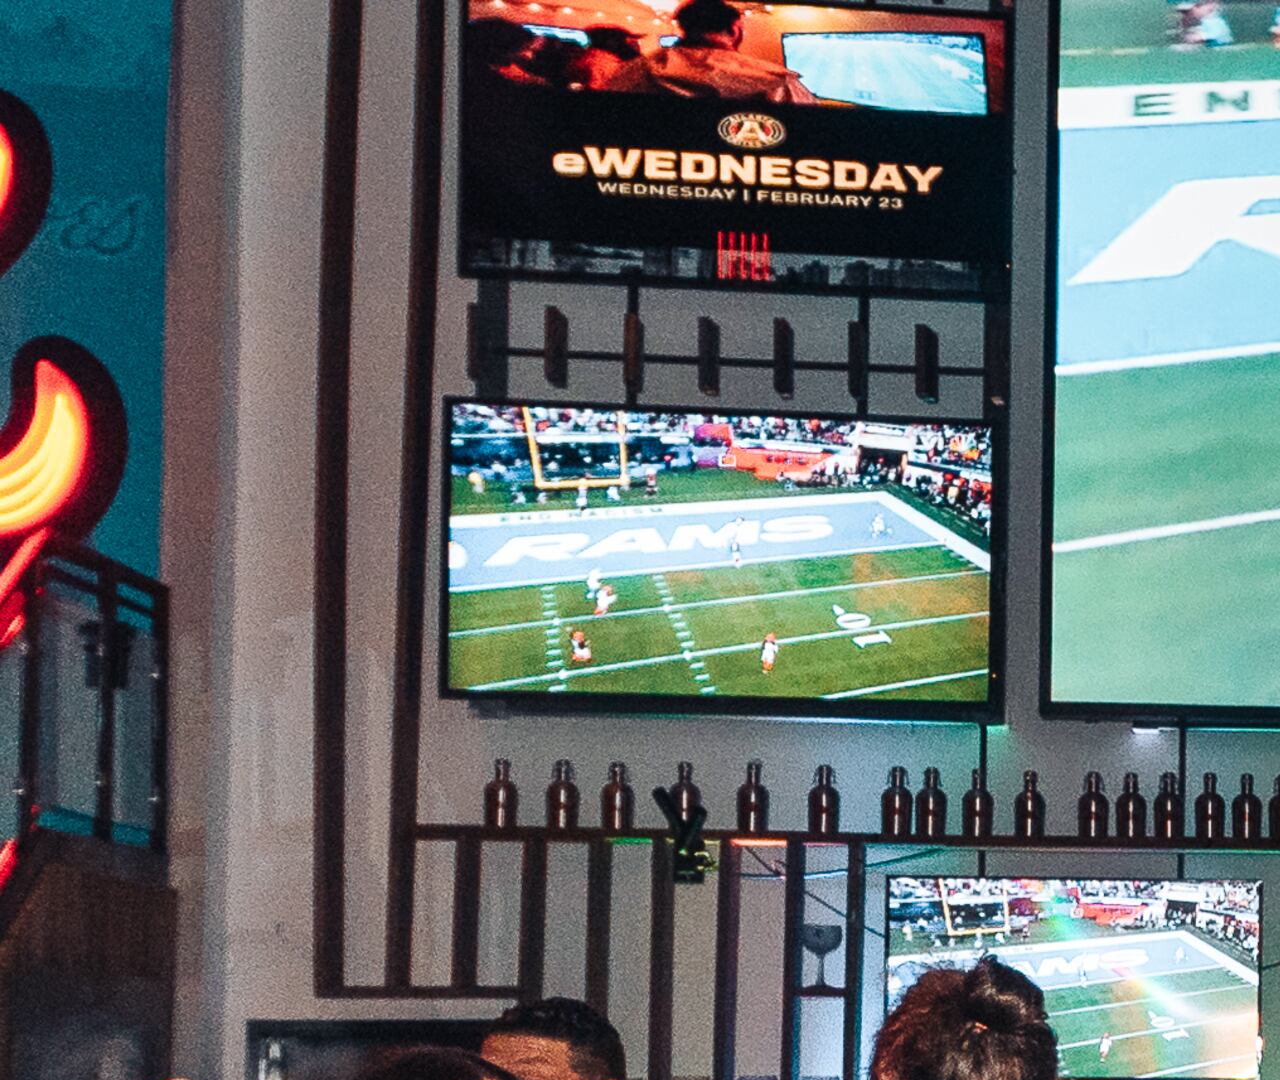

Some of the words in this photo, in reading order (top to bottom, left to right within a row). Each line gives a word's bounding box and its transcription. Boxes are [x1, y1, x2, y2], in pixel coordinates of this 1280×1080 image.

[552, 146, 944, 194] eWEDNESDAY
[597, 181, 736, 201] WEDNESDAY
[757, 189, 873, 210] FEBRUARY
[879, 196, 903, 210] 23
[483, 514, 835, 568] RAMS
[1009, 948, 1149, 978] AMS
